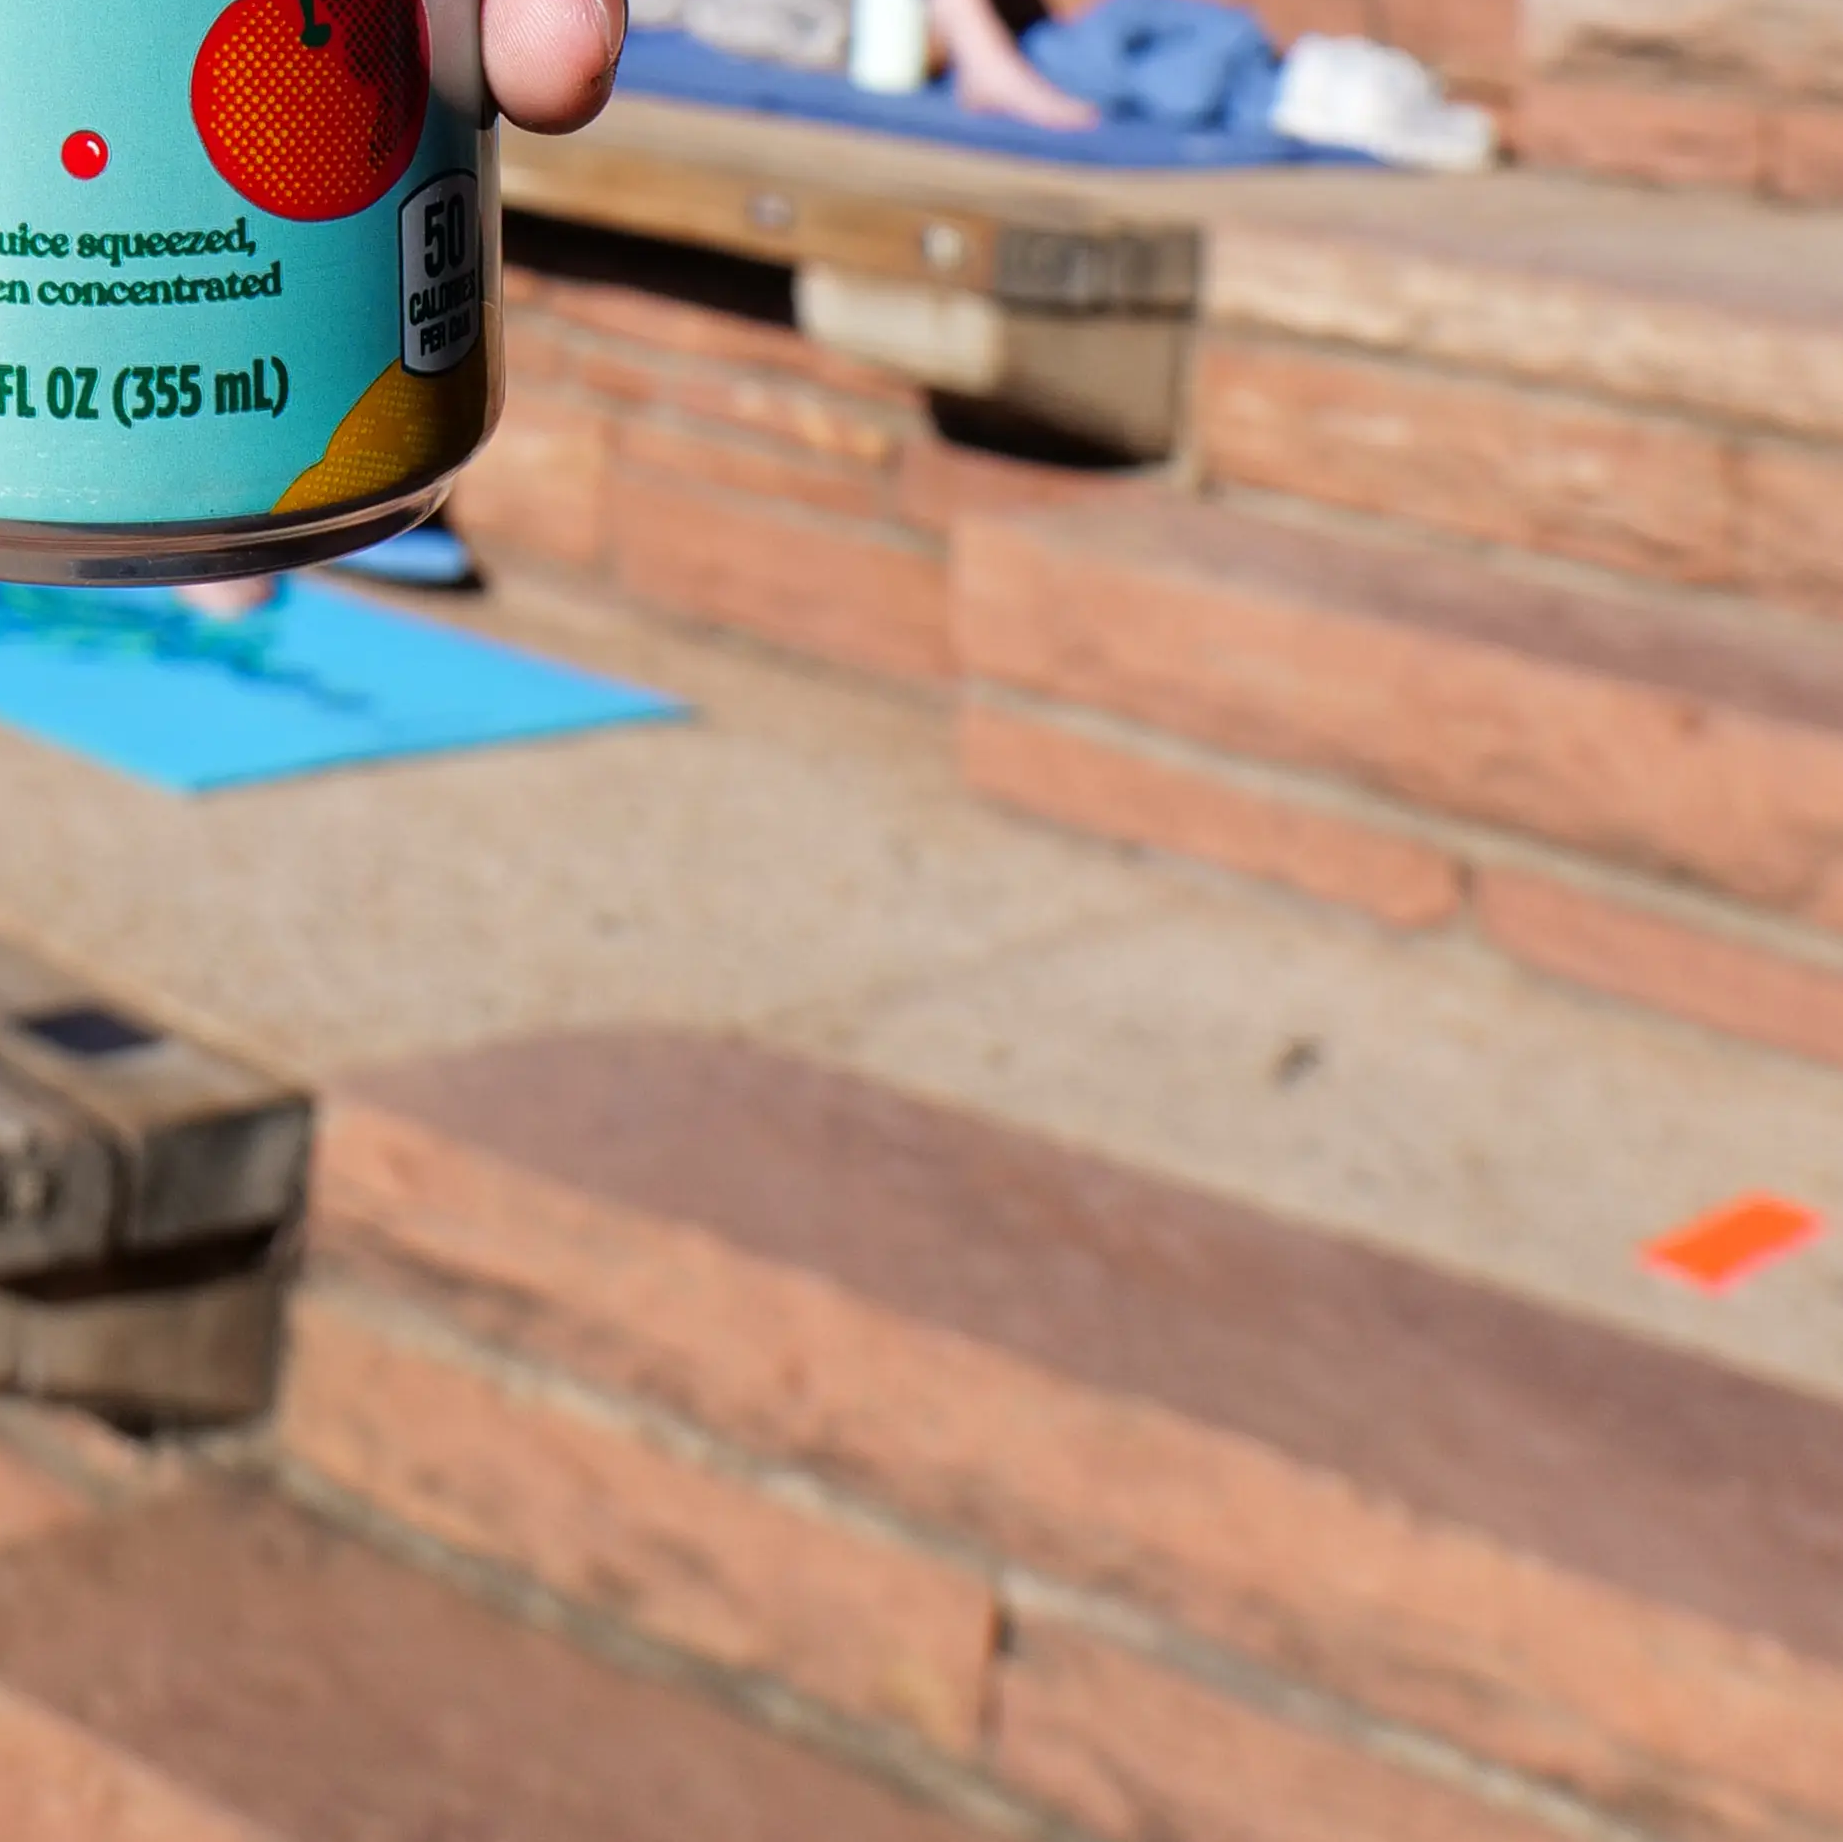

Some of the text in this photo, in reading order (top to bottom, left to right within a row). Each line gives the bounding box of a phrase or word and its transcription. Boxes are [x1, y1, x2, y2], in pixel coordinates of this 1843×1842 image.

[76, 216, 256, 268] squeezed,
[424, 193, 465, 278] 50
[37, 260, 283, 306] concentrated
[46, 365, 100, 419] OZ
[111, 364, 203, 429] (355
[214, 355, 289, 419] mL)
